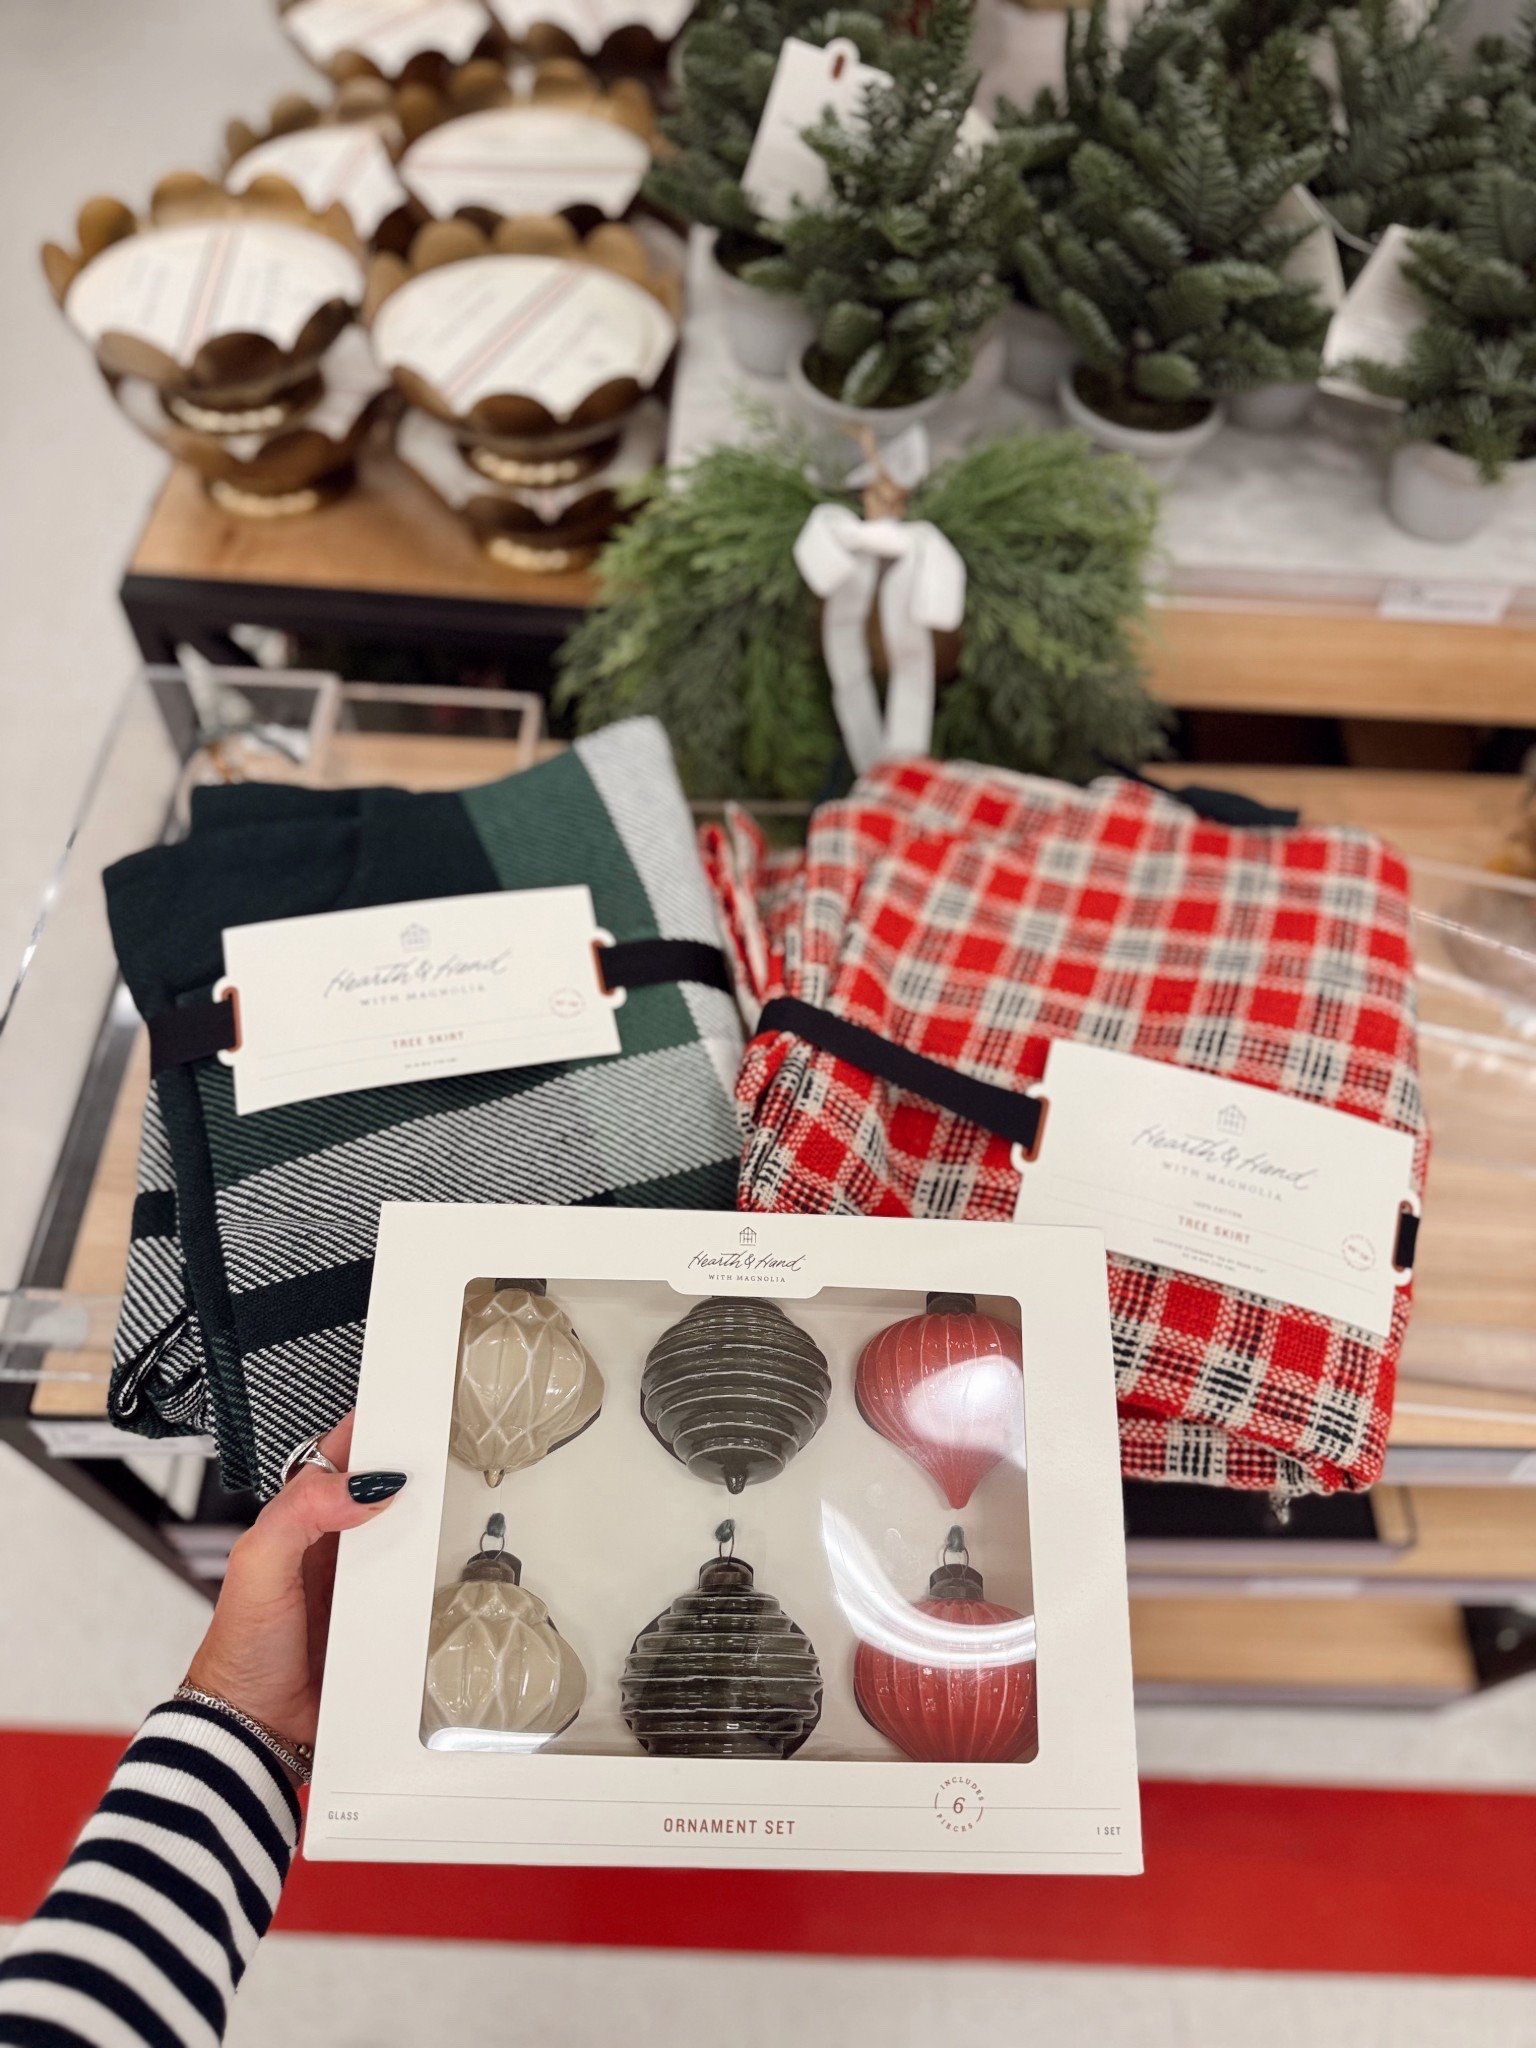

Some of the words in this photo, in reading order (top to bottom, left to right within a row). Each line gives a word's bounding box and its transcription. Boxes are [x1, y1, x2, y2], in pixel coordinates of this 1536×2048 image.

[359, 993, 400, 1007] WITH
[405, 983, 485, 1001] MAGNOLIA
[393, 1036, 422, 1050] TREE
[428, 1029, 464, 1045] SKIRT
[1131, 1124, 1229, 1163] Hearth
[1220, 1146, 1240, 1168] &
[1235, 1152, 1319, 1190] Hand
[1161, 1160, 1201, 1178] WITH
[1205, 1172, 1283, 1202] MAGNOLIA
[1178, 1214, 1209, 1233] TREE
[1214, 1225, 1251, 1245] SKIRT
[688, 1250, 748, 1269] Hearth
[744, 1253, 756, 1269] &
[754, 1252, 804, 1272] Hand
[708, 1273, 733, 1282] WITH
[736, 1274, 786, 1284] MAGNOLIA
[940, 1776, 984, 1801] INCLUDES
[328, 1810, 359, 1821] GLASS
[953, 1796, 966, 1814] 6
[663, 1817, 758, 1834] ORNAMENT
[764, 1819, 796, 1835] SET
[936, 1813, 973, 1833] PIECES
[1104, 1826, 1121, 1836] SET
